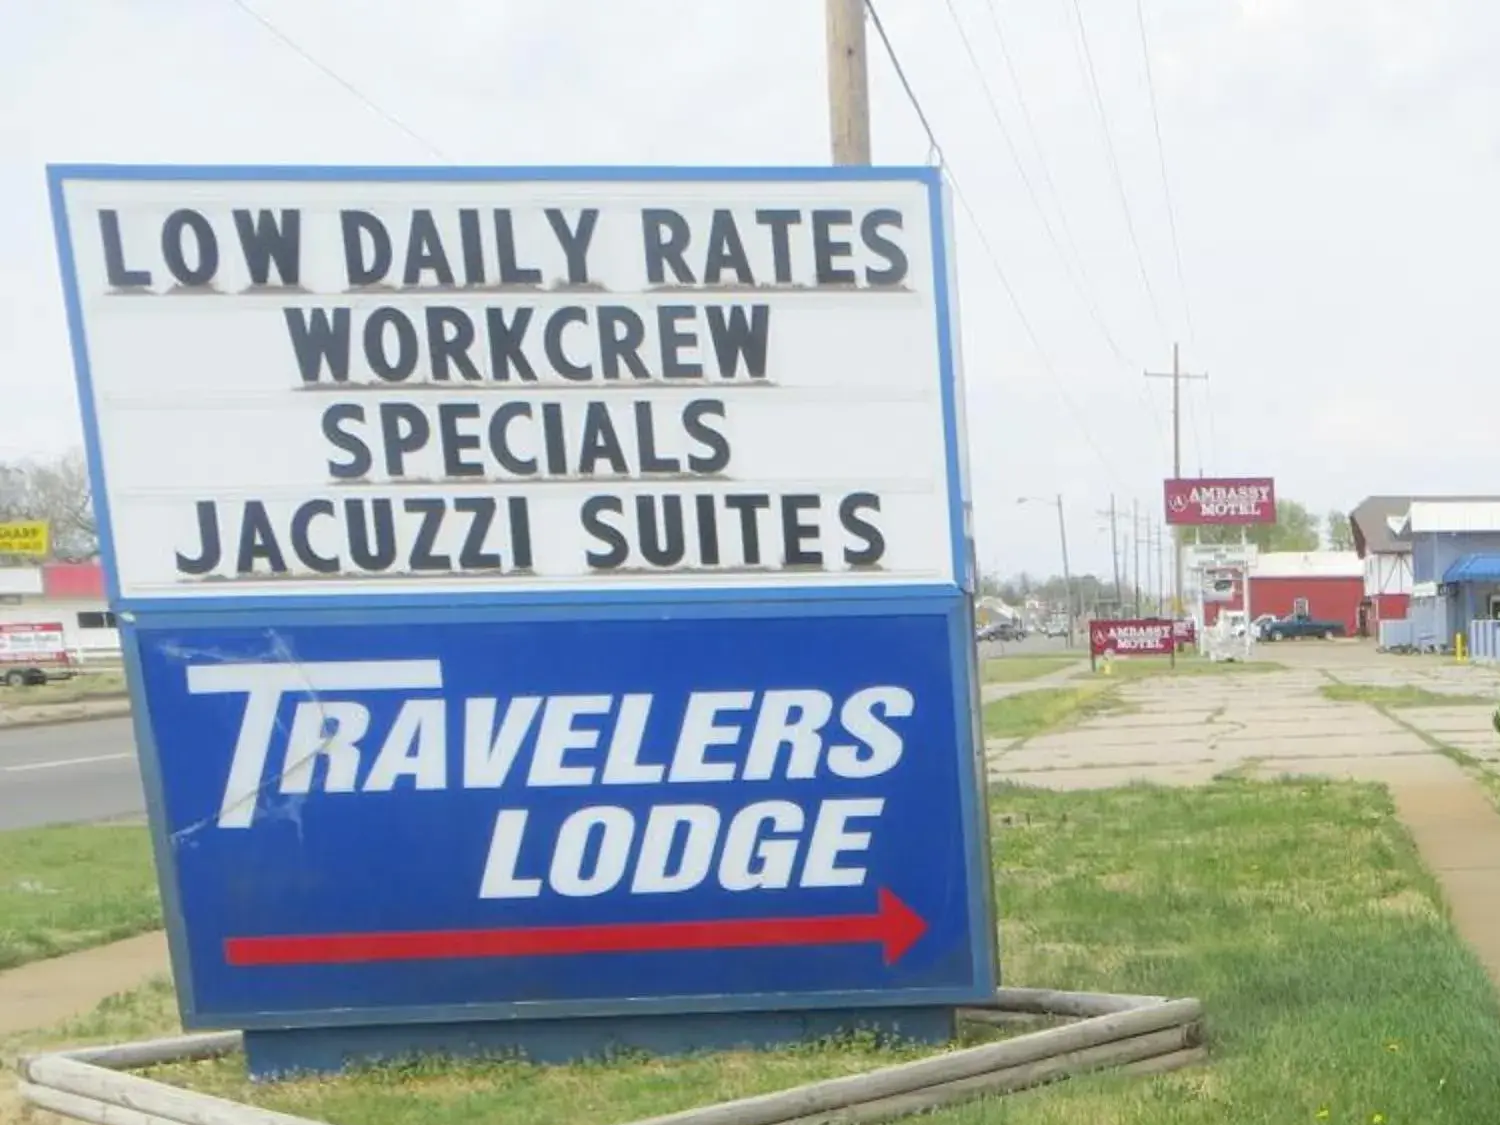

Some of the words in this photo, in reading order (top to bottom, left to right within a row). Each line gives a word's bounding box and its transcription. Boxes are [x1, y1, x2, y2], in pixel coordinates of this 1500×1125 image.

[98, 207, 302, 288] LOW
[340, 208, 599, 288] DAILY
[641, 207, 909, 288] RATES
[283, 303, 771, 383] WORKCREW
[321, 399, 733, 478] SPECIALS
[174, 494, 533, 576] JACUZZI
[584, 491, 887, 571] SUITES
[1201, 503, 1261, 516] MOTEL
[1117, 639, 1164, 649] MOTEL
[186, 659, 914, 829] TRAVELERS
[478, 798, 885, 899] LODGE
